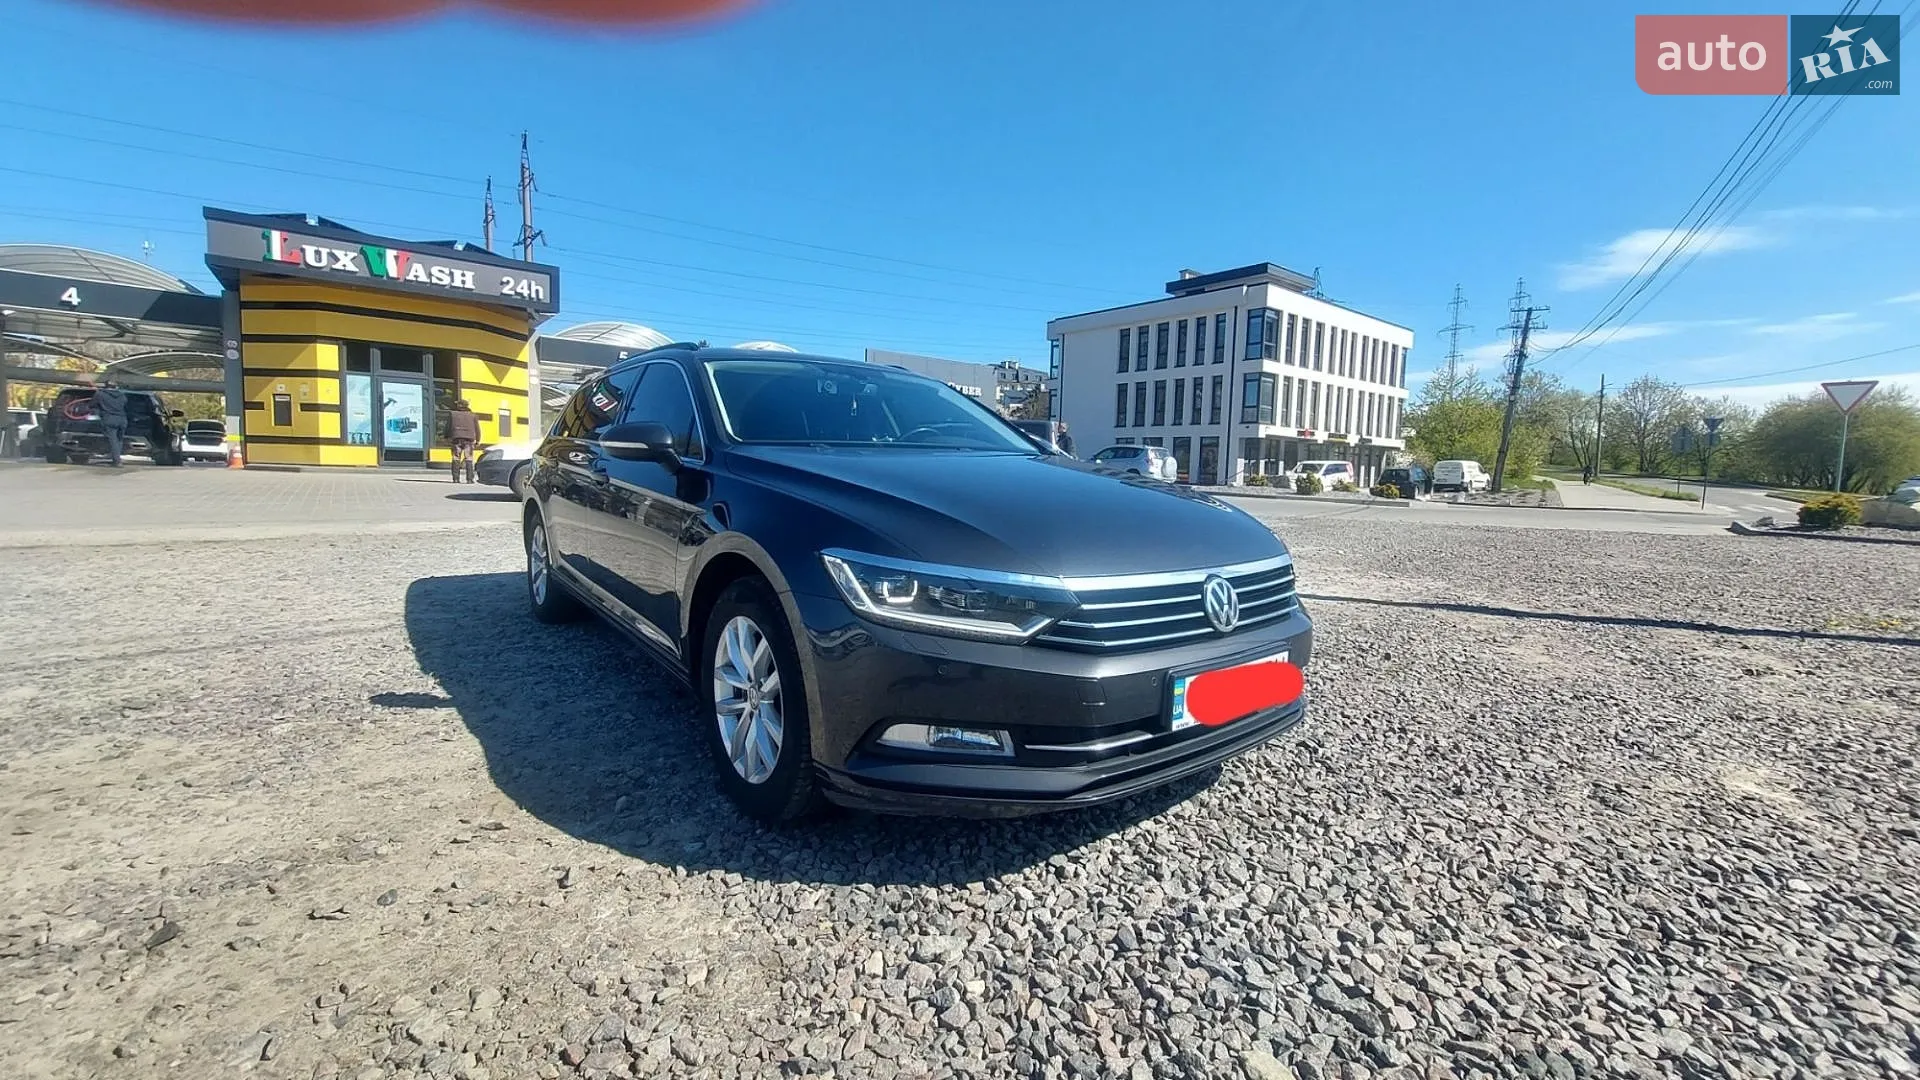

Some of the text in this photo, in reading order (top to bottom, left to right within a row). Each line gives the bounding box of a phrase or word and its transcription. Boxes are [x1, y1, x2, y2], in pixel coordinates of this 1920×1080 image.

[61, 287, 81, 306] 4
[502, 276, 544, 300] 24h
[1173, 703, 1183, 715] UA
